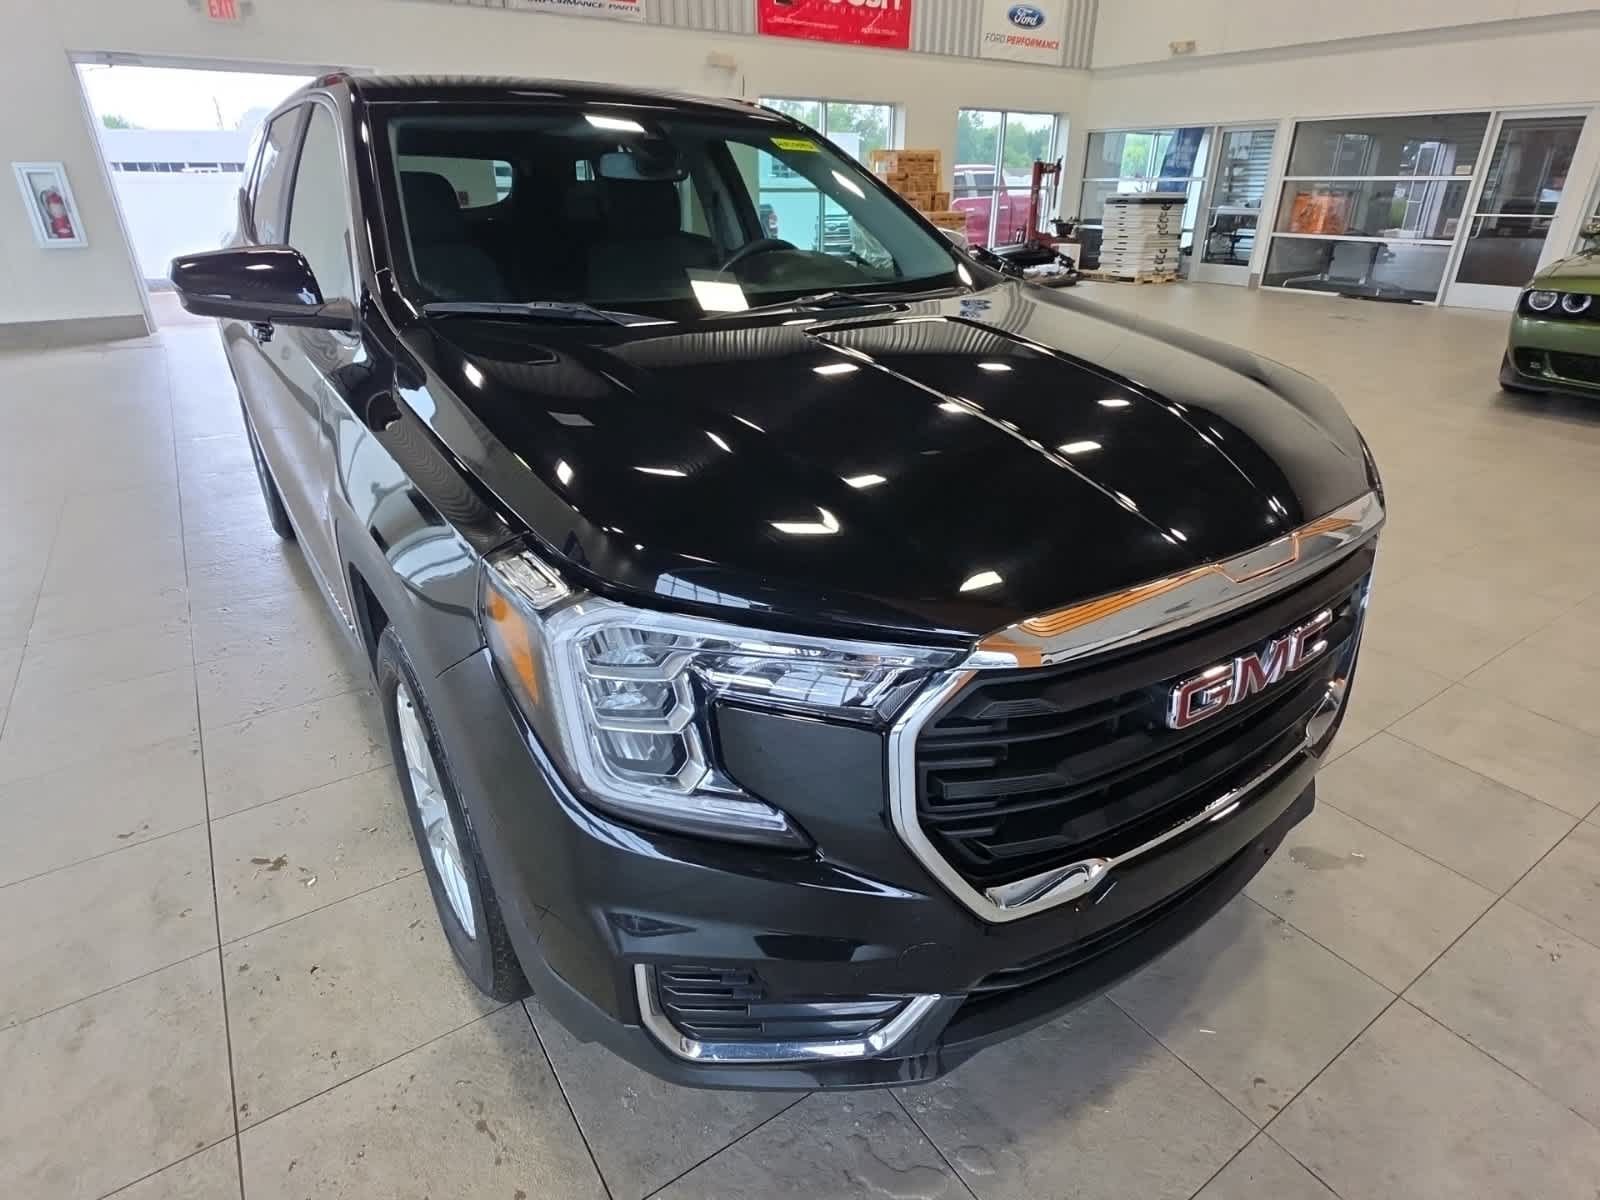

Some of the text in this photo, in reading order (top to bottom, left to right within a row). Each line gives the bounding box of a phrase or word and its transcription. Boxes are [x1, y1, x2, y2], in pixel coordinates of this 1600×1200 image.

[1014, 7, 1040, 26] Ford
[984, 32, 1060, 50] FORD PERFORMANCE
[1167, 608, 1333, 729] GMC
